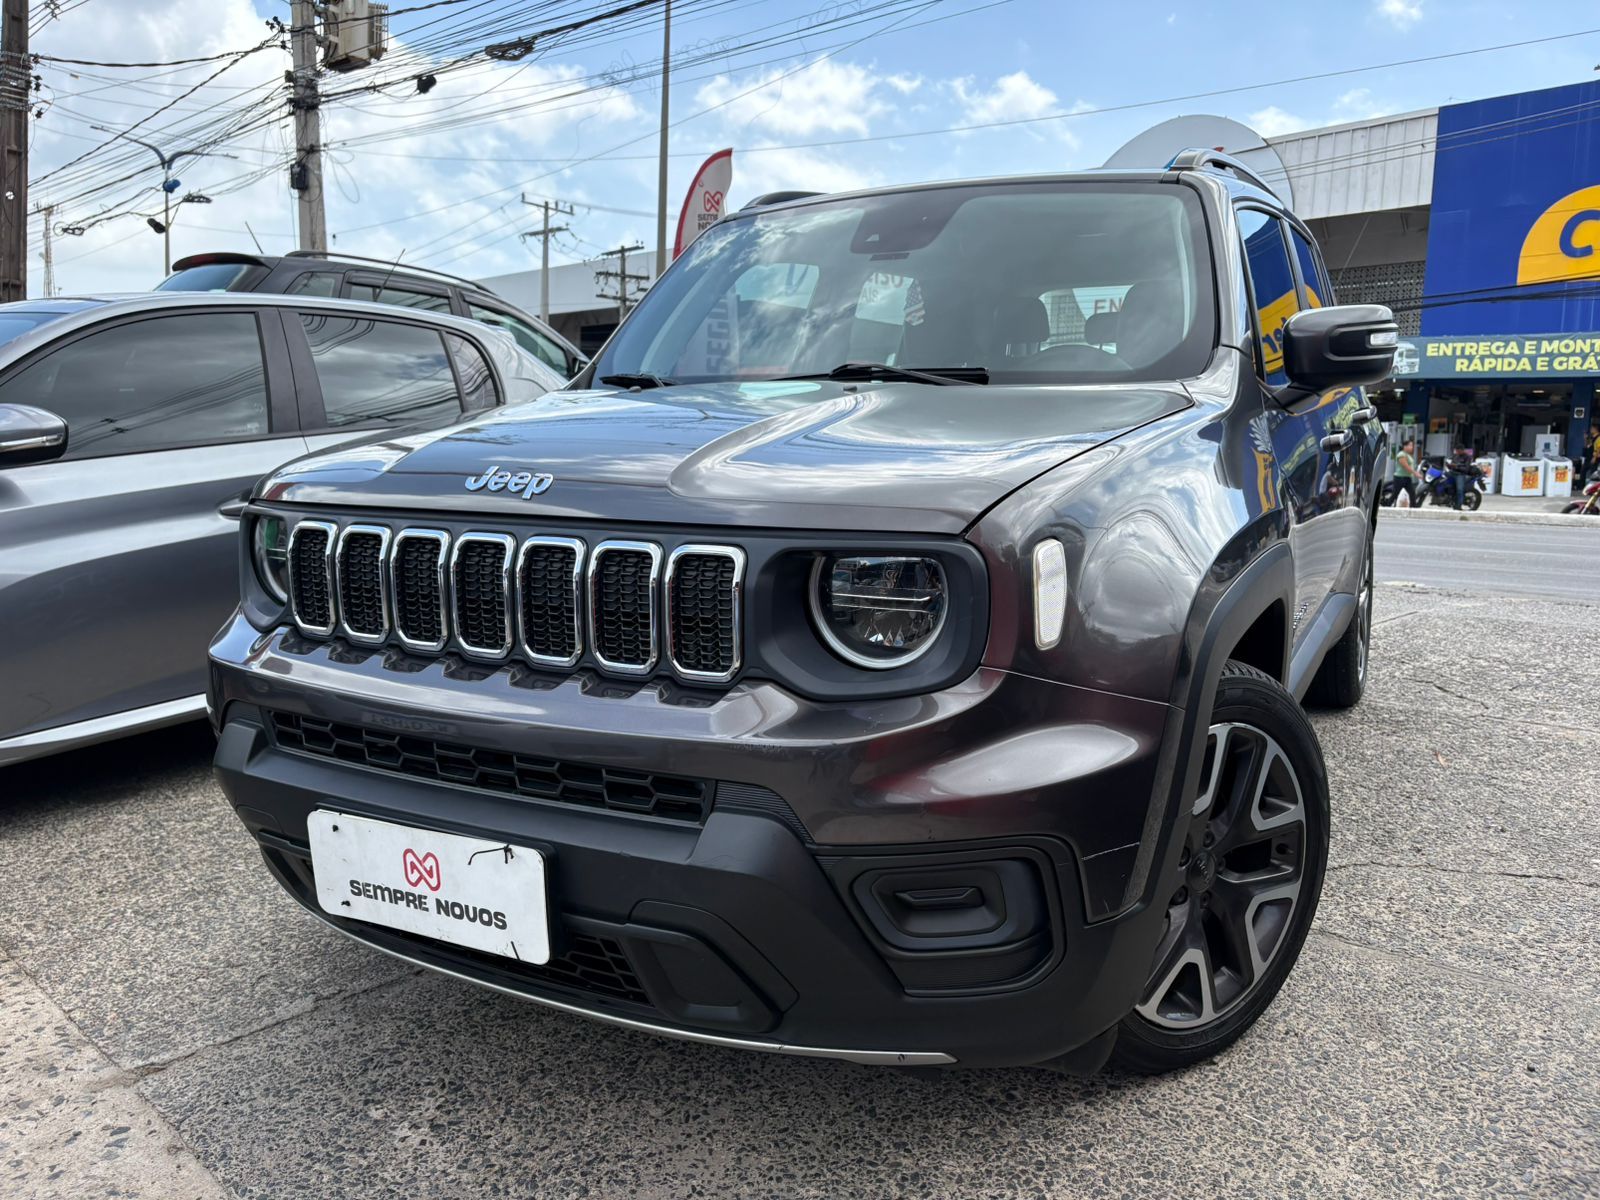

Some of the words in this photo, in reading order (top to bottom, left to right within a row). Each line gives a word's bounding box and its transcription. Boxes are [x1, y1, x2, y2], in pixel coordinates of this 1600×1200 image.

[1426, 341, 1520, 356] ENTREGA
[1524, 341, 1537, 355] E
[1455, 355, 1531, 372] RÁPIDA
[1536, 357, 1549, 371] E
[465, 465, 553, 500] Jeep
[350, 880, 429, 912] SEMPRE
